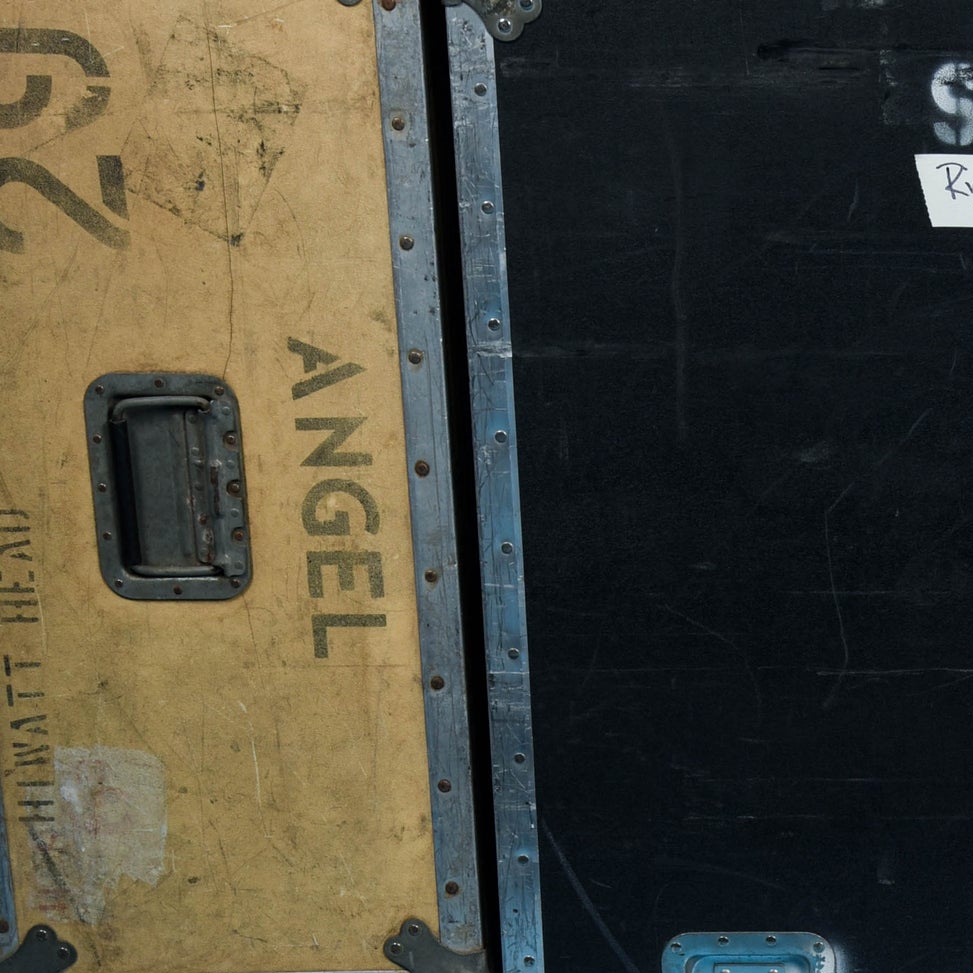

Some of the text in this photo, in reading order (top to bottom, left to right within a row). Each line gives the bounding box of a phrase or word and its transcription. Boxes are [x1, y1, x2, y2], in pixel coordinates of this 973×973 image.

[287, 336, 386, 658] ANGEL
[0, 508, 55, 823] HIWATT HEAD
